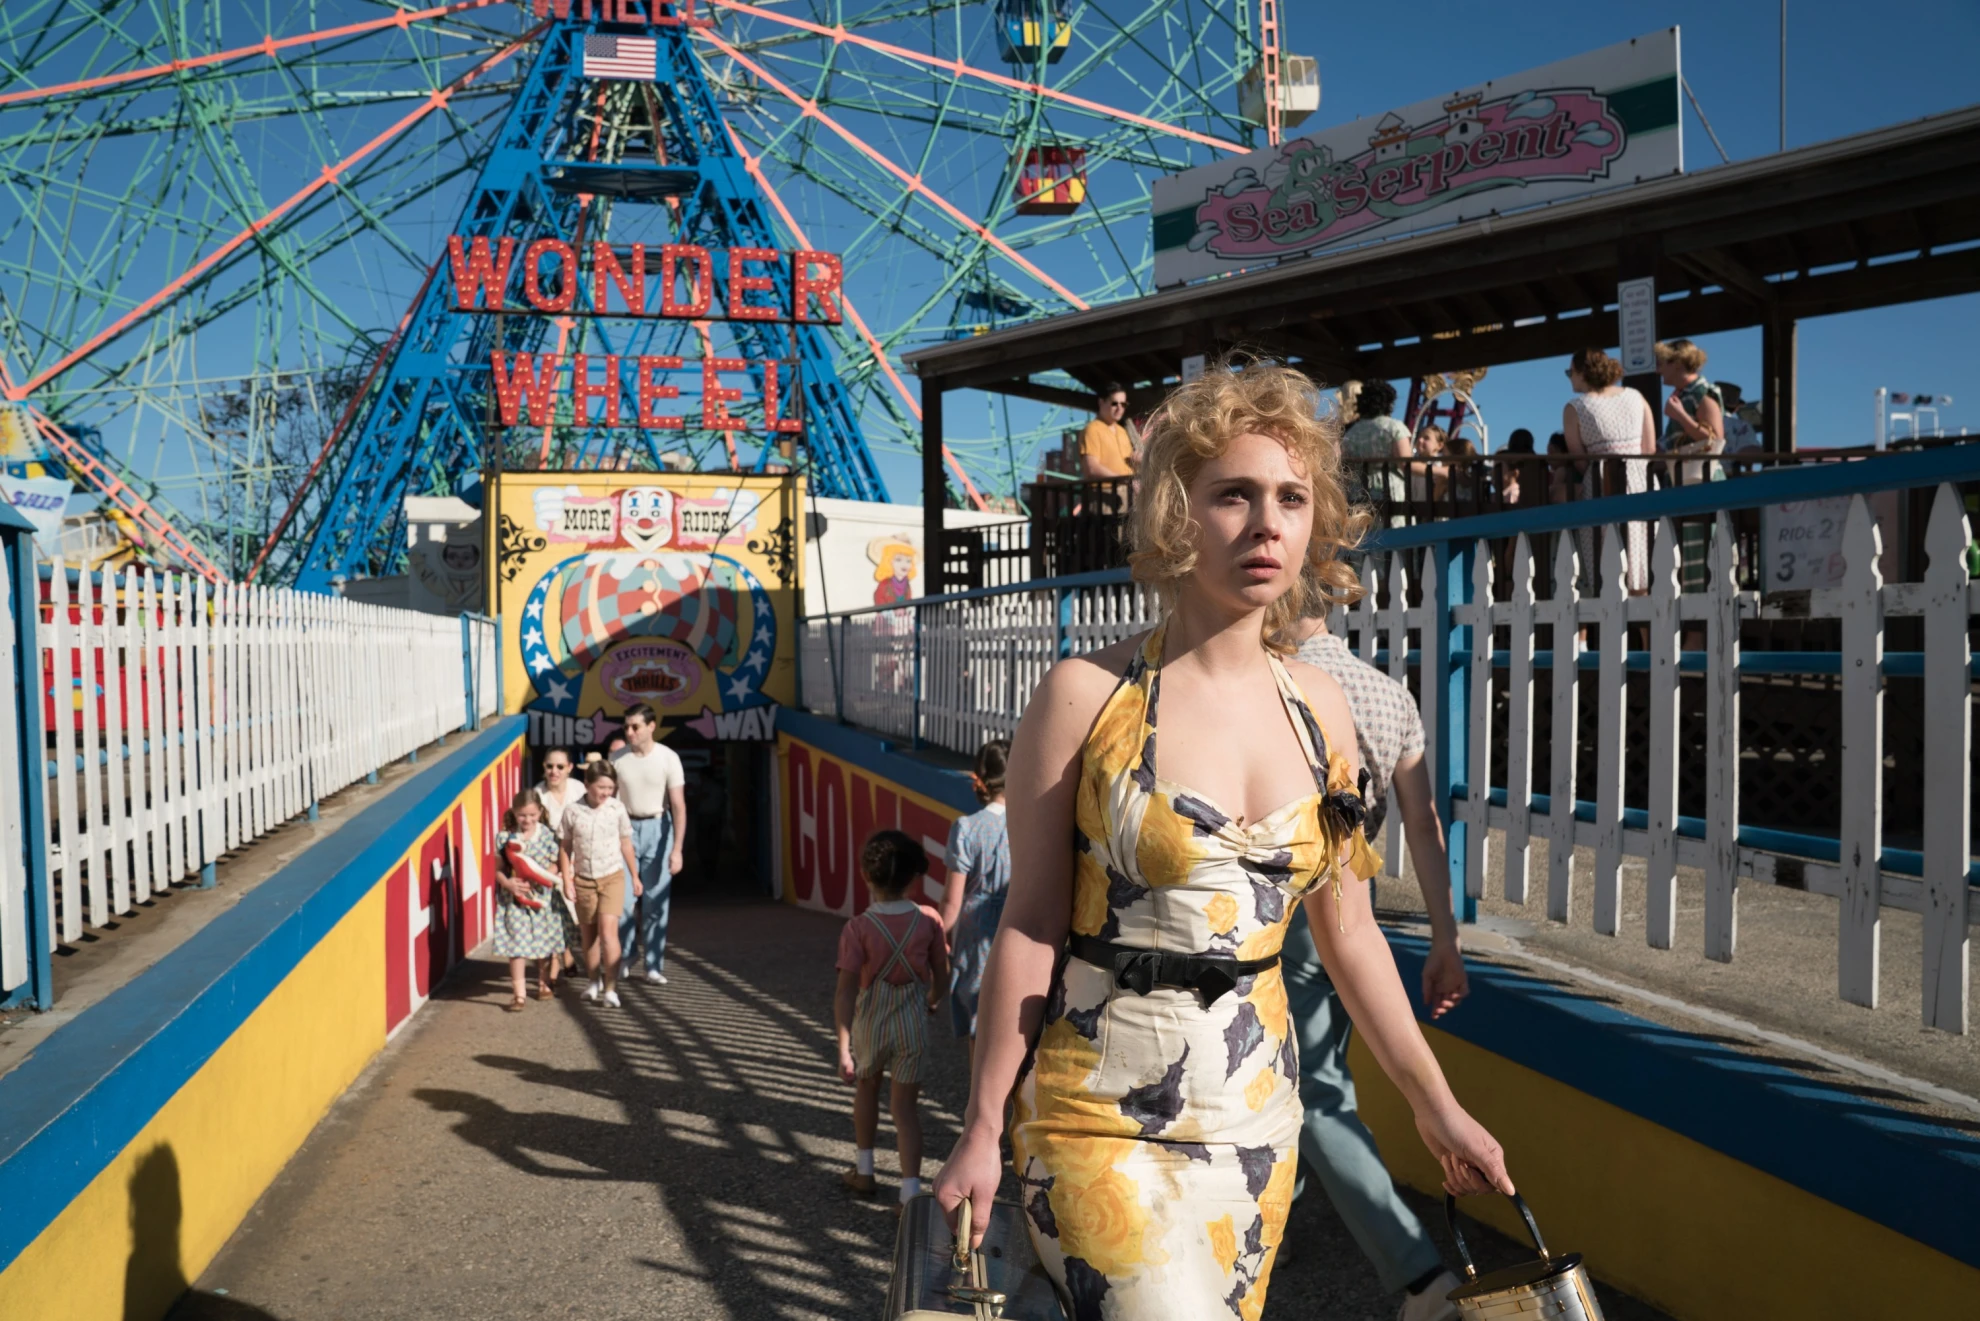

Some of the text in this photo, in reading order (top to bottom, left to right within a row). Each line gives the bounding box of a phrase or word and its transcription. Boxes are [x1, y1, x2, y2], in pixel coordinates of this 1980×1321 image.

[1226, 111, 1574, 242] Sea Serpent
[447, 235, 842, 324] WONDER
[491, 351, 802, 431] WHEEL
[12, 490, 64, 510] SHIP
[564, 508, 729, 533] MORE RIDES
[1778, 525, 1817, 542] RIDE
[615, 646, 688, 661] EXCITEMENT
[624, 672, 680, 691] THRILLS
[528, 704, 777, 746] THIS WAY
